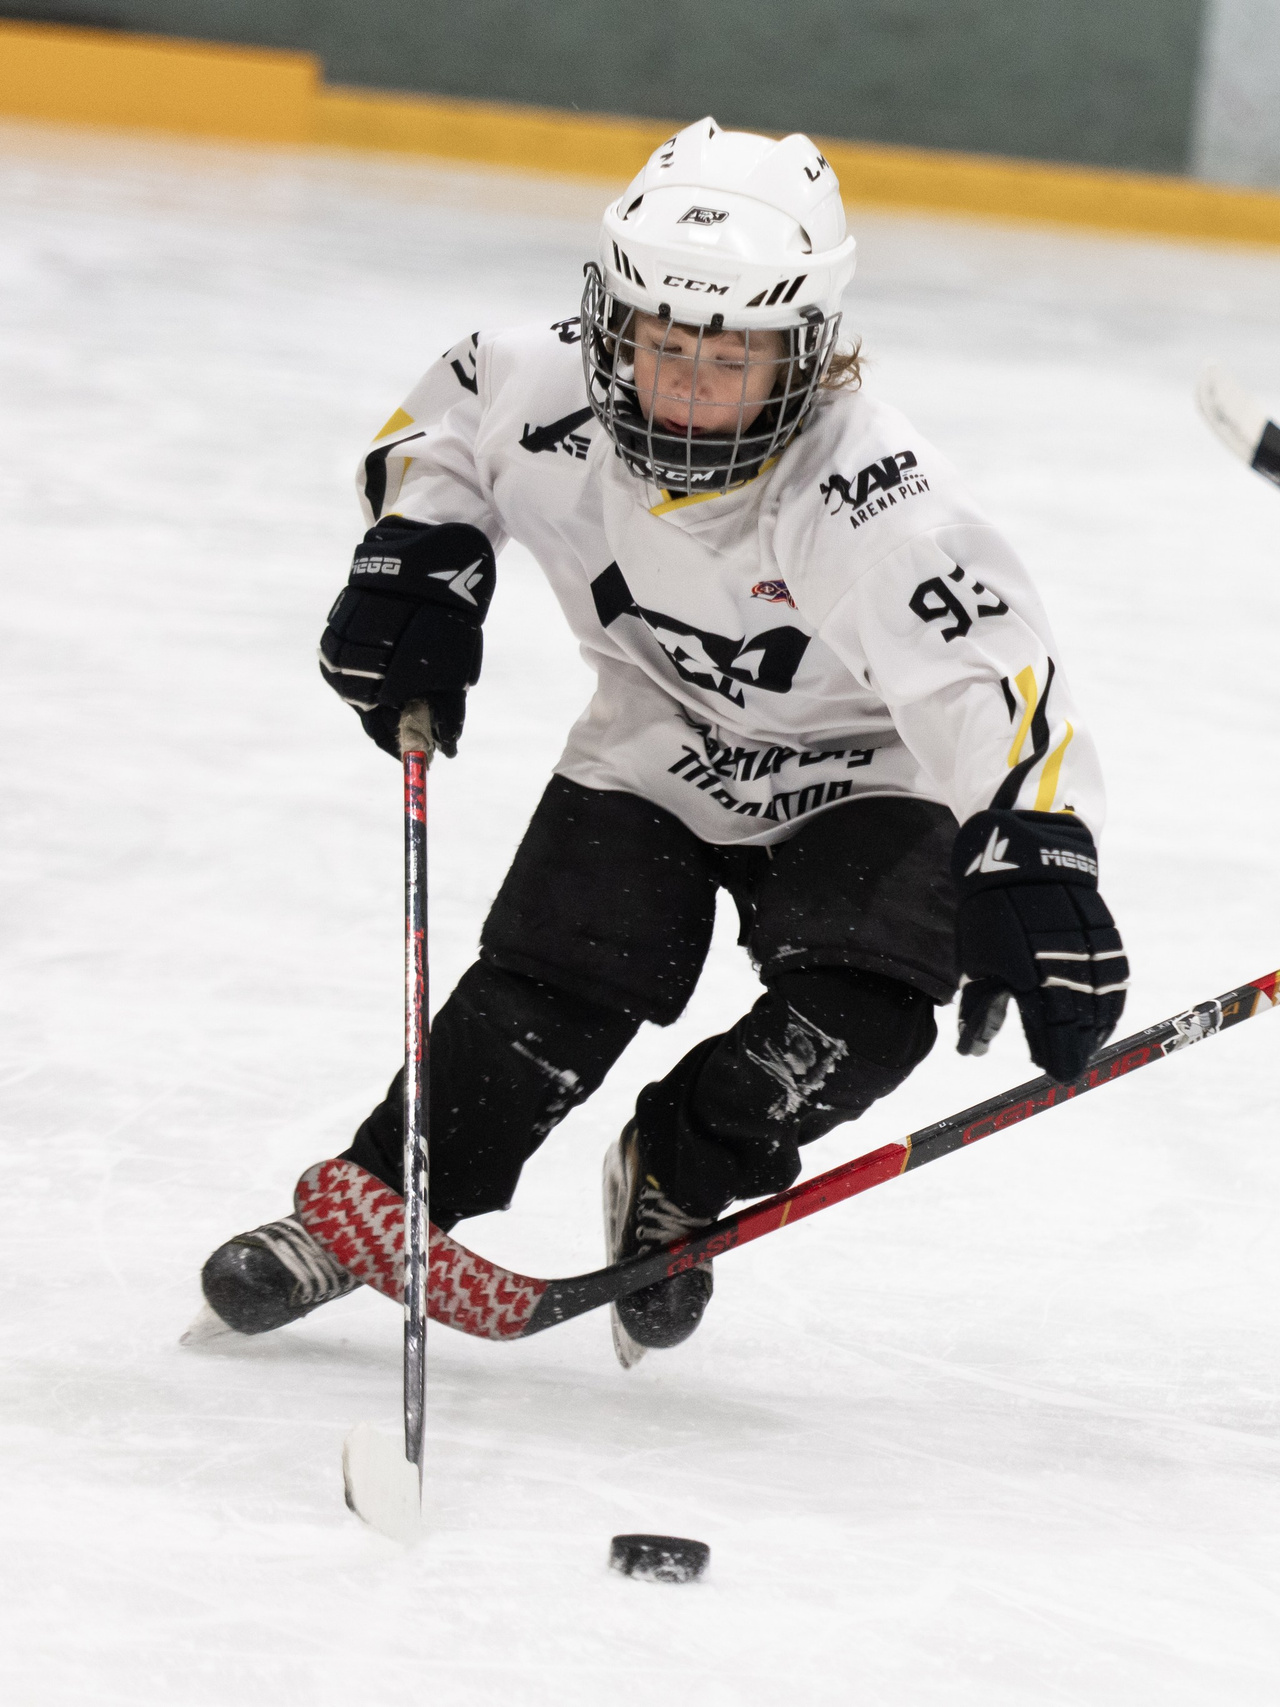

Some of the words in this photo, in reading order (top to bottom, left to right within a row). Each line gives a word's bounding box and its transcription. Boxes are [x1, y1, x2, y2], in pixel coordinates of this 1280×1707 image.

[662, 274, 730, 296] CCM
[849, 492, 898, 530] ARENA
[899, 478, 931, 501] PLAY
[353, 556, 402, 576] EGA
